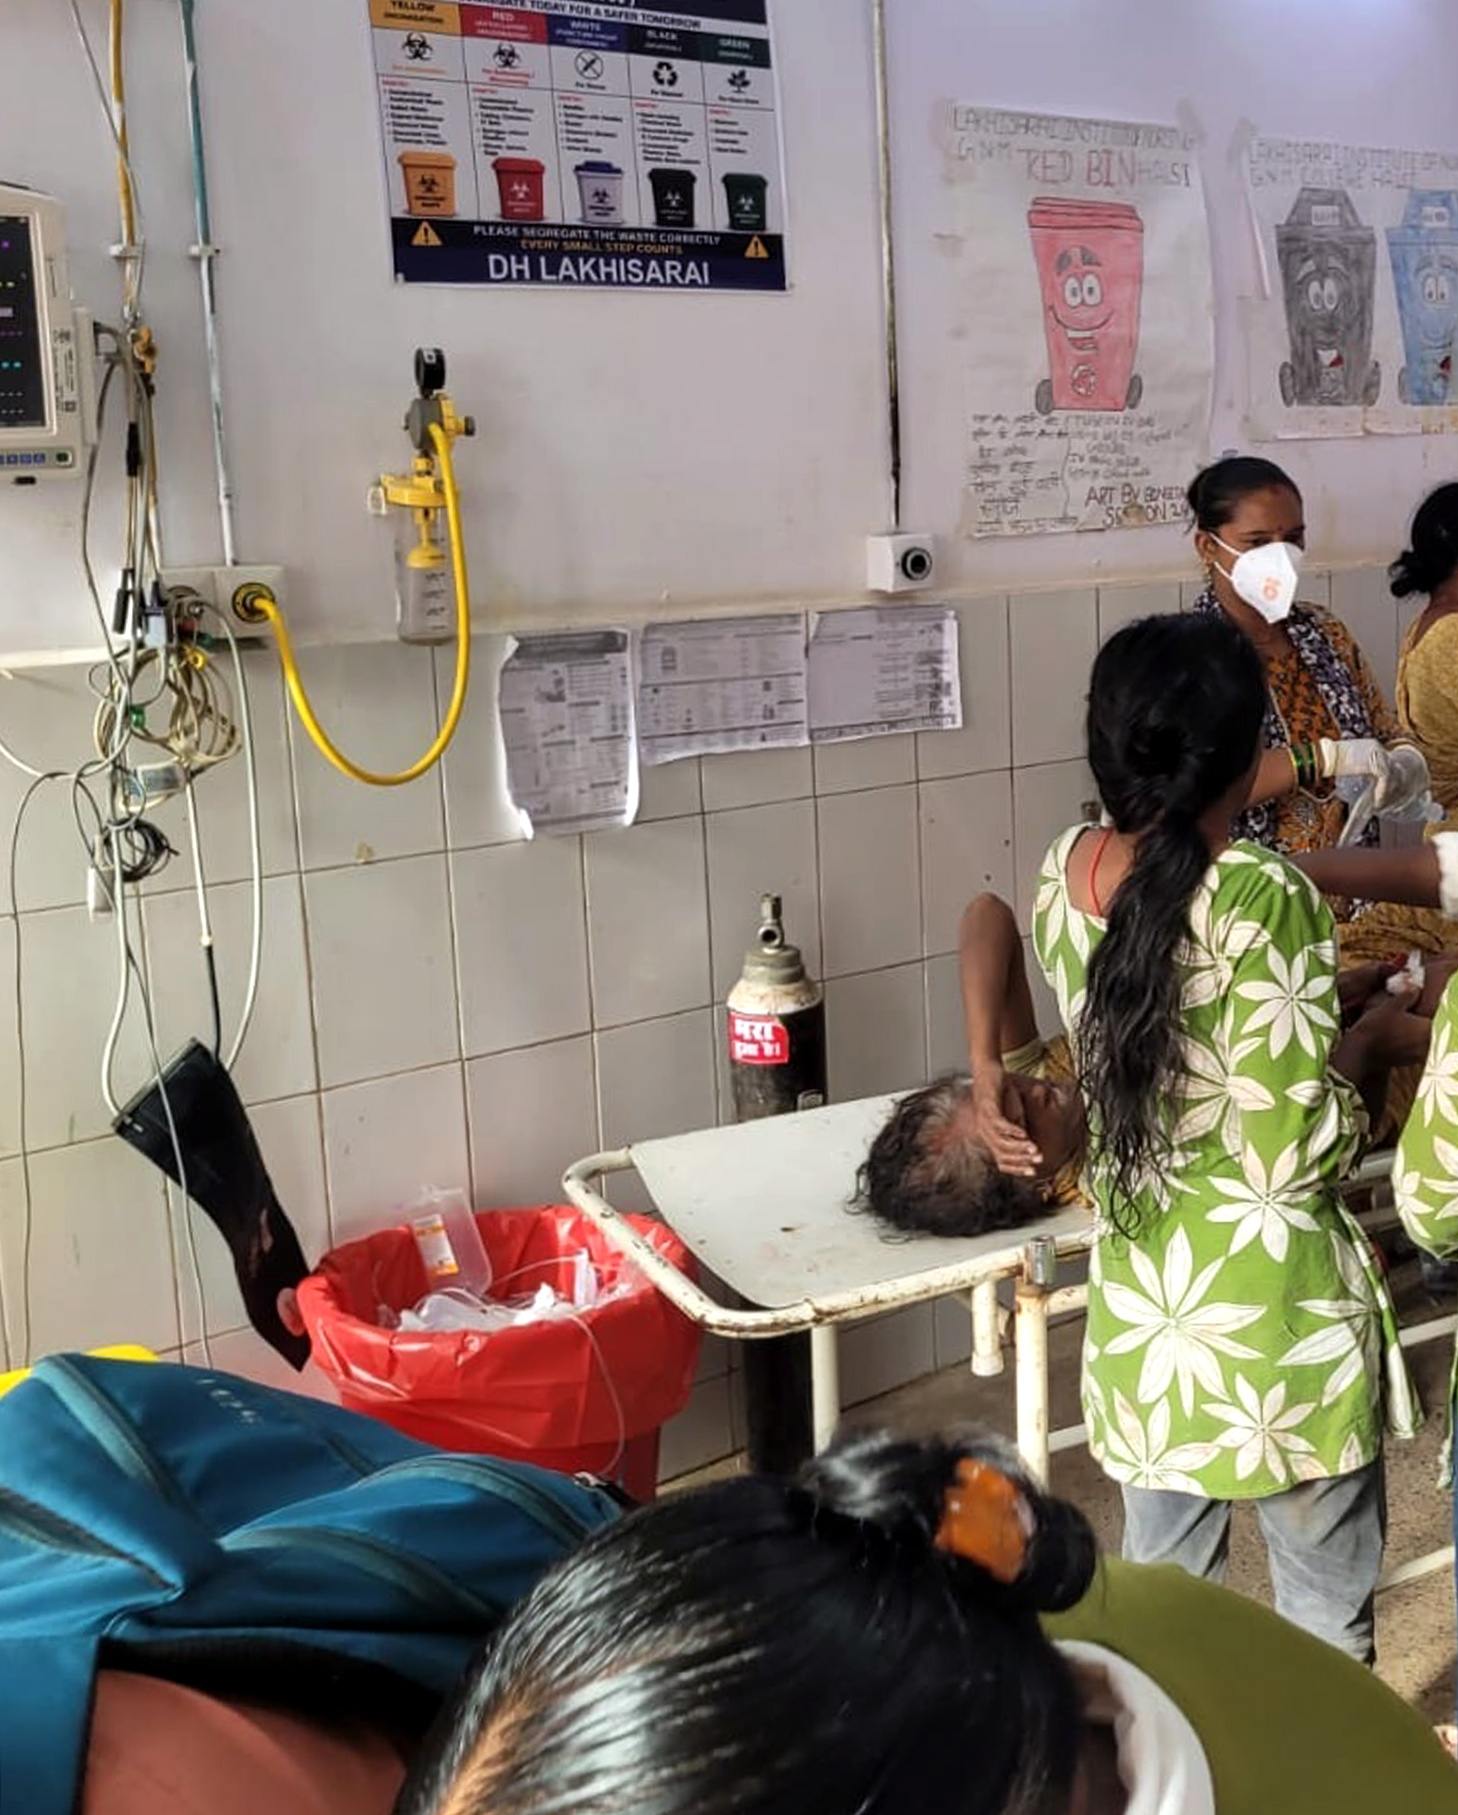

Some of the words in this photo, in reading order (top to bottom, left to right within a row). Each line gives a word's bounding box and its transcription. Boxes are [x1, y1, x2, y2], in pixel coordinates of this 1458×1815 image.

[391, 1, 436, 12] YELLOW
[530, 1, 567, 12] TODAY
[569, 4, 591, 15] FOR
[593, 7, 602, 16] A
[603, 8, 638, 20] SAFER
[640, 13, 701, 28] TOMORROW
[492, 10, 516, 21] RED
[570, 20, 601, 31] WHITE
[646, 29, 678, 40] BLACK
[719, 38, 750, 49] GREEN
[1016, 148, 1074, 185] RED
[1086, 149, 1136, 187] BIN
[473, 225, 518, 237] PLEASE
[522, 227, 590, 240] SEGREGATE
[594, 229, 615, 241] THE
[617, 231, 656, 243] WASTE
[659, 232, 720, 246] CORRECTLY
[520, 239, 559, 250] EVERY
[562, 240, 601, 252] SMALL
[605, 242, 634, 253] STEP
[636, 243, 683, 255] COUNTS
[488, 254, 531, 280] DH
[540, 254, 710, 285] LAKHISARAI
[1085, 486, 1116, 507] ART
[1121, 483, 1140, 504] BY
